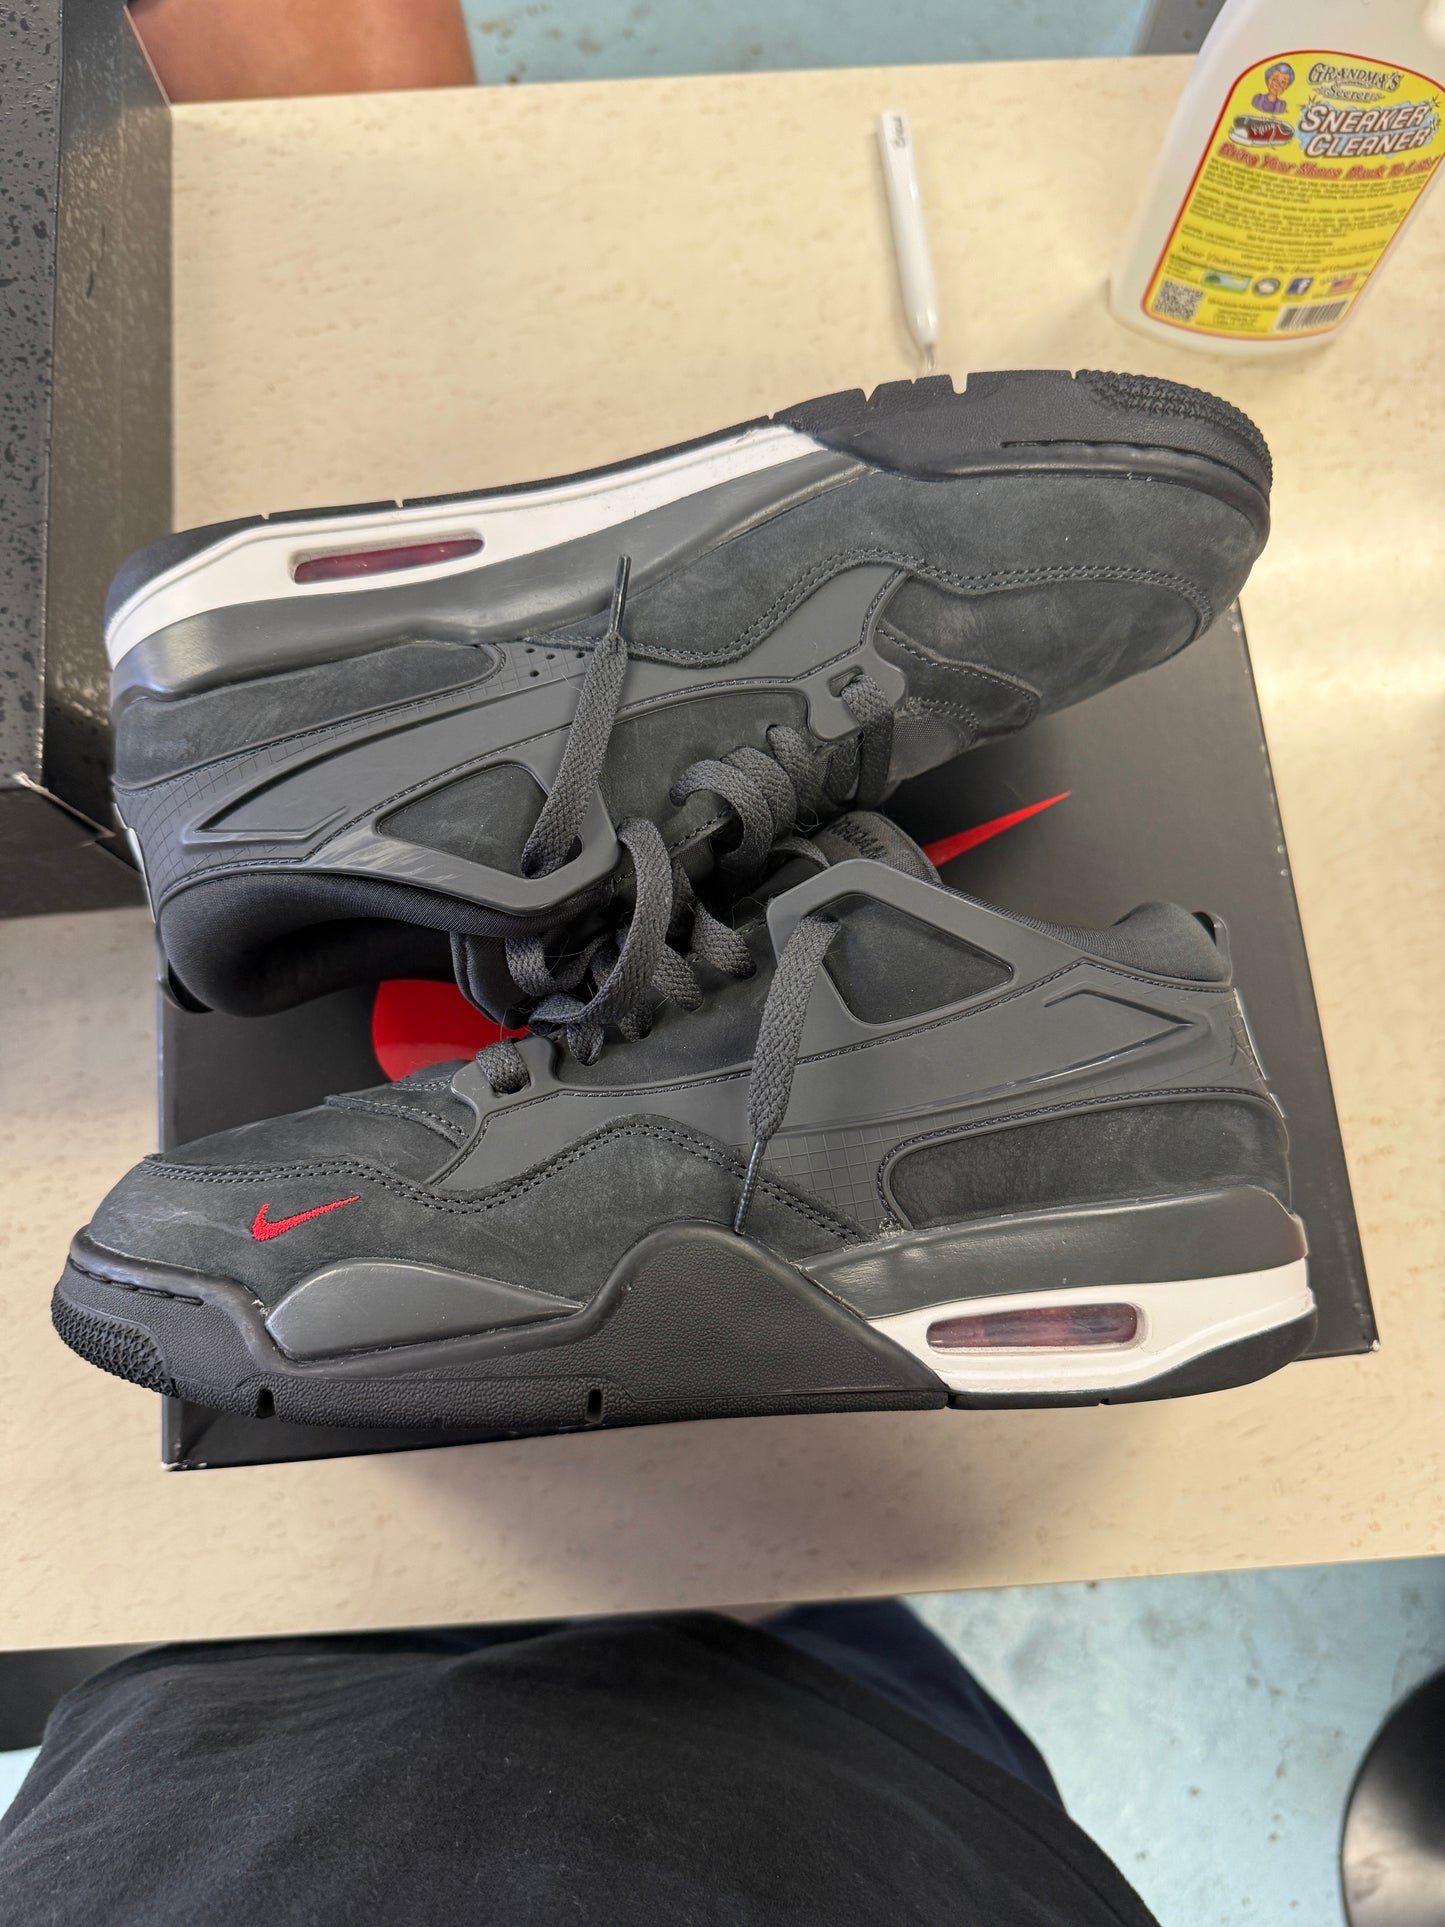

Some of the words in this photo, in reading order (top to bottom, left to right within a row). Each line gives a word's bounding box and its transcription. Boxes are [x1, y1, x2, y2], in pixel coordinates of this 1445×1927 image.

[1307, 61, 1404, 93] GRANDMA'S
[1300, 102, 1431, 135] SNEAKER
[1304, 128, 1431, 159] CLEANER
